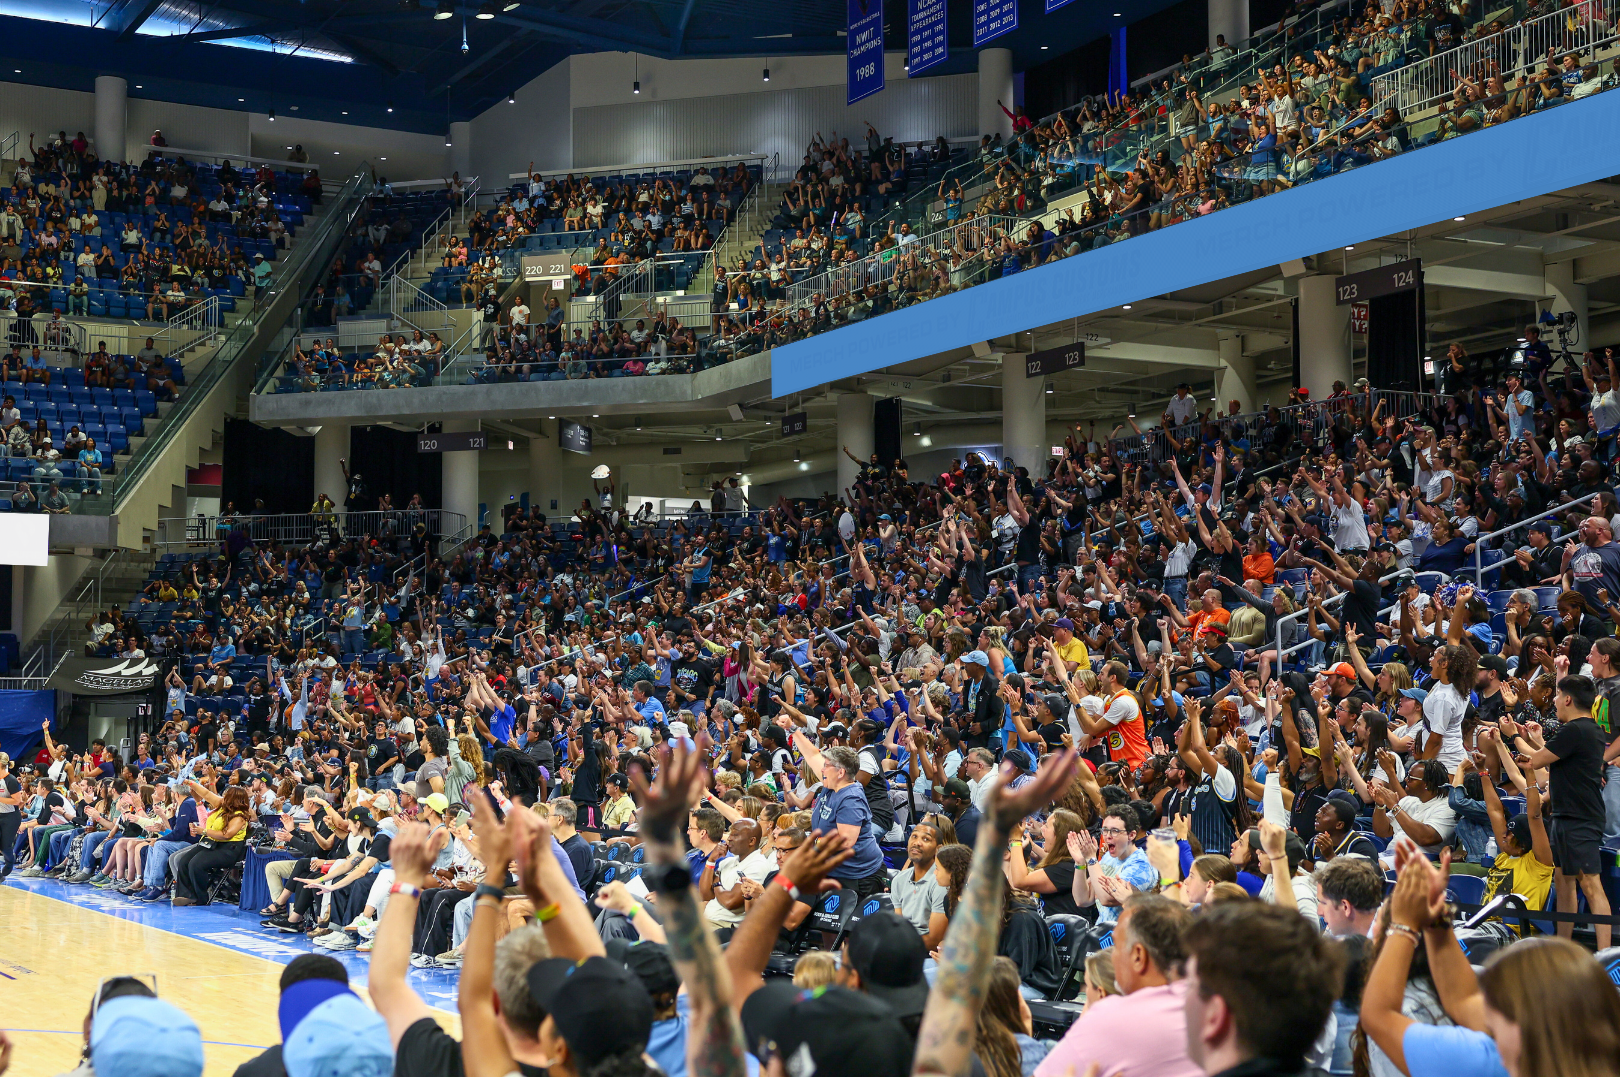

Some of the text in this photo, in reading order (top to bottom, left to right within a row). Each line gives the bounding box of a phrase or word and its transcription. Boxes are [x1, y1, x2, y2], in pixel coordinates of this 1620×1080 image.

[912, 2, 943, 22] TOURNAMENT
[1003, 2, 1013, 12] 2010
[911, 11, 944, 32] APPEARANCES
[977, 14, 1013, 36] 2011 2012 2013
[856, 27, 874, 45] NWIT
[850, 37, 881, 58] CHAMPIONS
[856, 62, 874, 81] 1988
[1195, 214, 1290, 258] MERCH
[1298, 165, 1454, 229] POWERED
[1464, 148, 1510, 182] BY
[526, 266, 543, 275] 220
[550, 264, 564, 273] 221
[1339, 270, 1414, 300] 123 124
[790, 342, 844, 374] MERCH
[848, 320, 932, 358] POWERED
[936, 310, 961, 332] BY
[1052, 249, 1142, 300] CUSTOMS
[1086, 333, 1098, 341] 122
[1028, 352, 1079, 374] 122 123
[420, 438, 484, 449] 120 121
[81, 675, 154, 684] MAGELLAN
